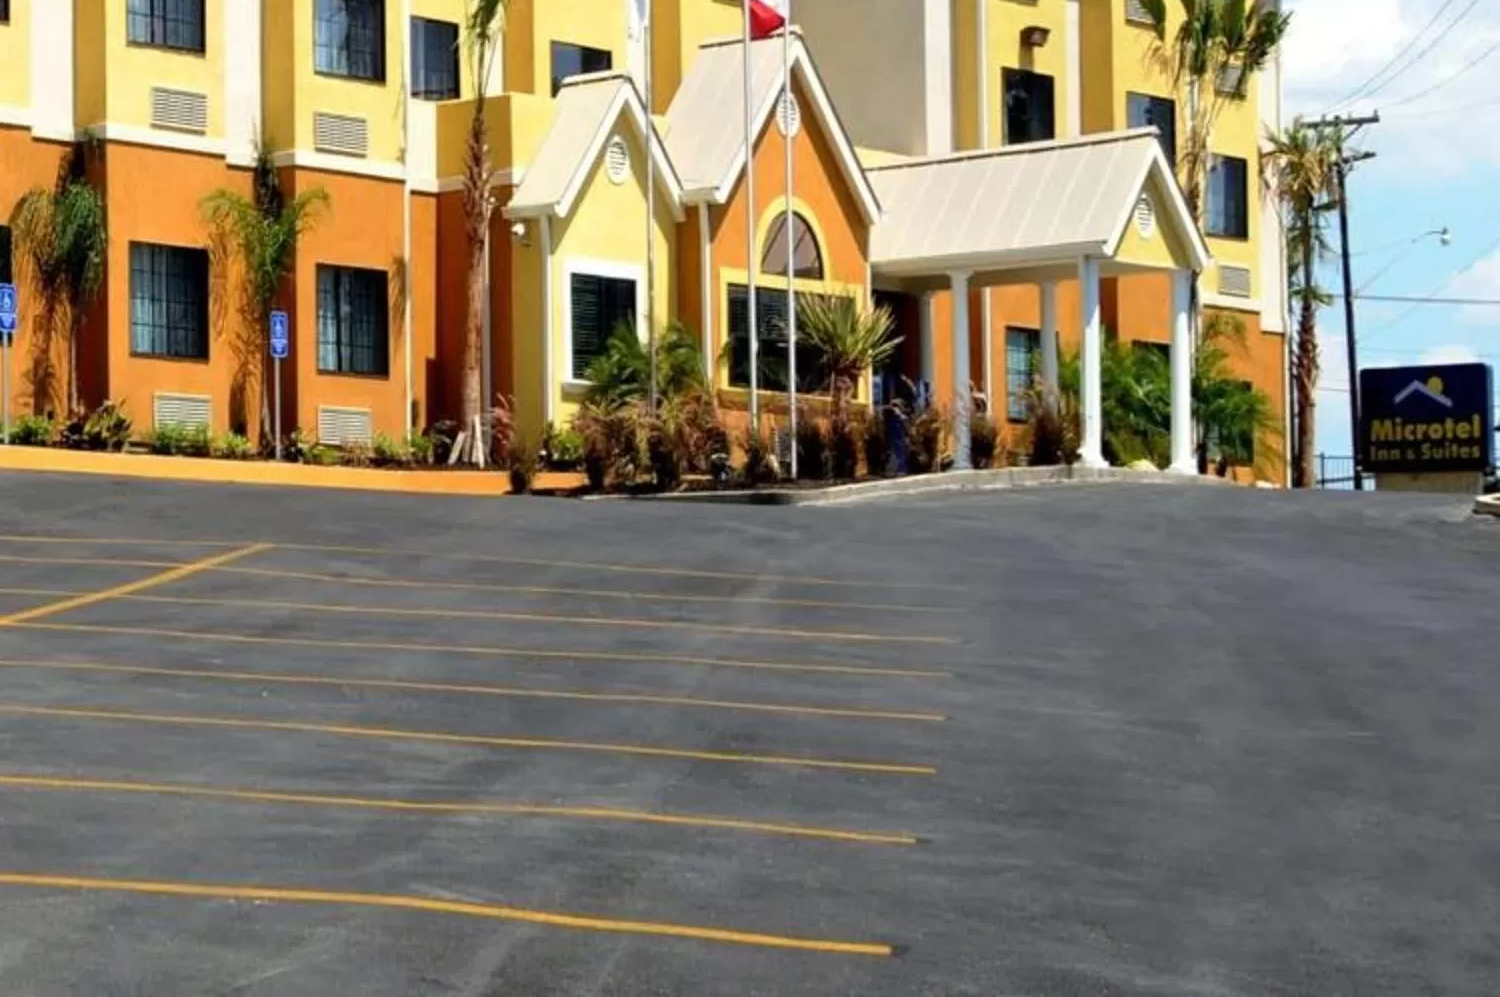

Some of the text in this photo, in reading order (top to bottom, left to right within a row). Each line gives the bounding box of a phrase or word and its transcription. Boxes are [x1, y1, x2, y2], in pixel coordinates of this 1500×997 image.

[1370, 413, 1482, 442] Microtel
[1370, 446, 1401, 461] Inn
[1421, 441, 1481, 460] Suites
